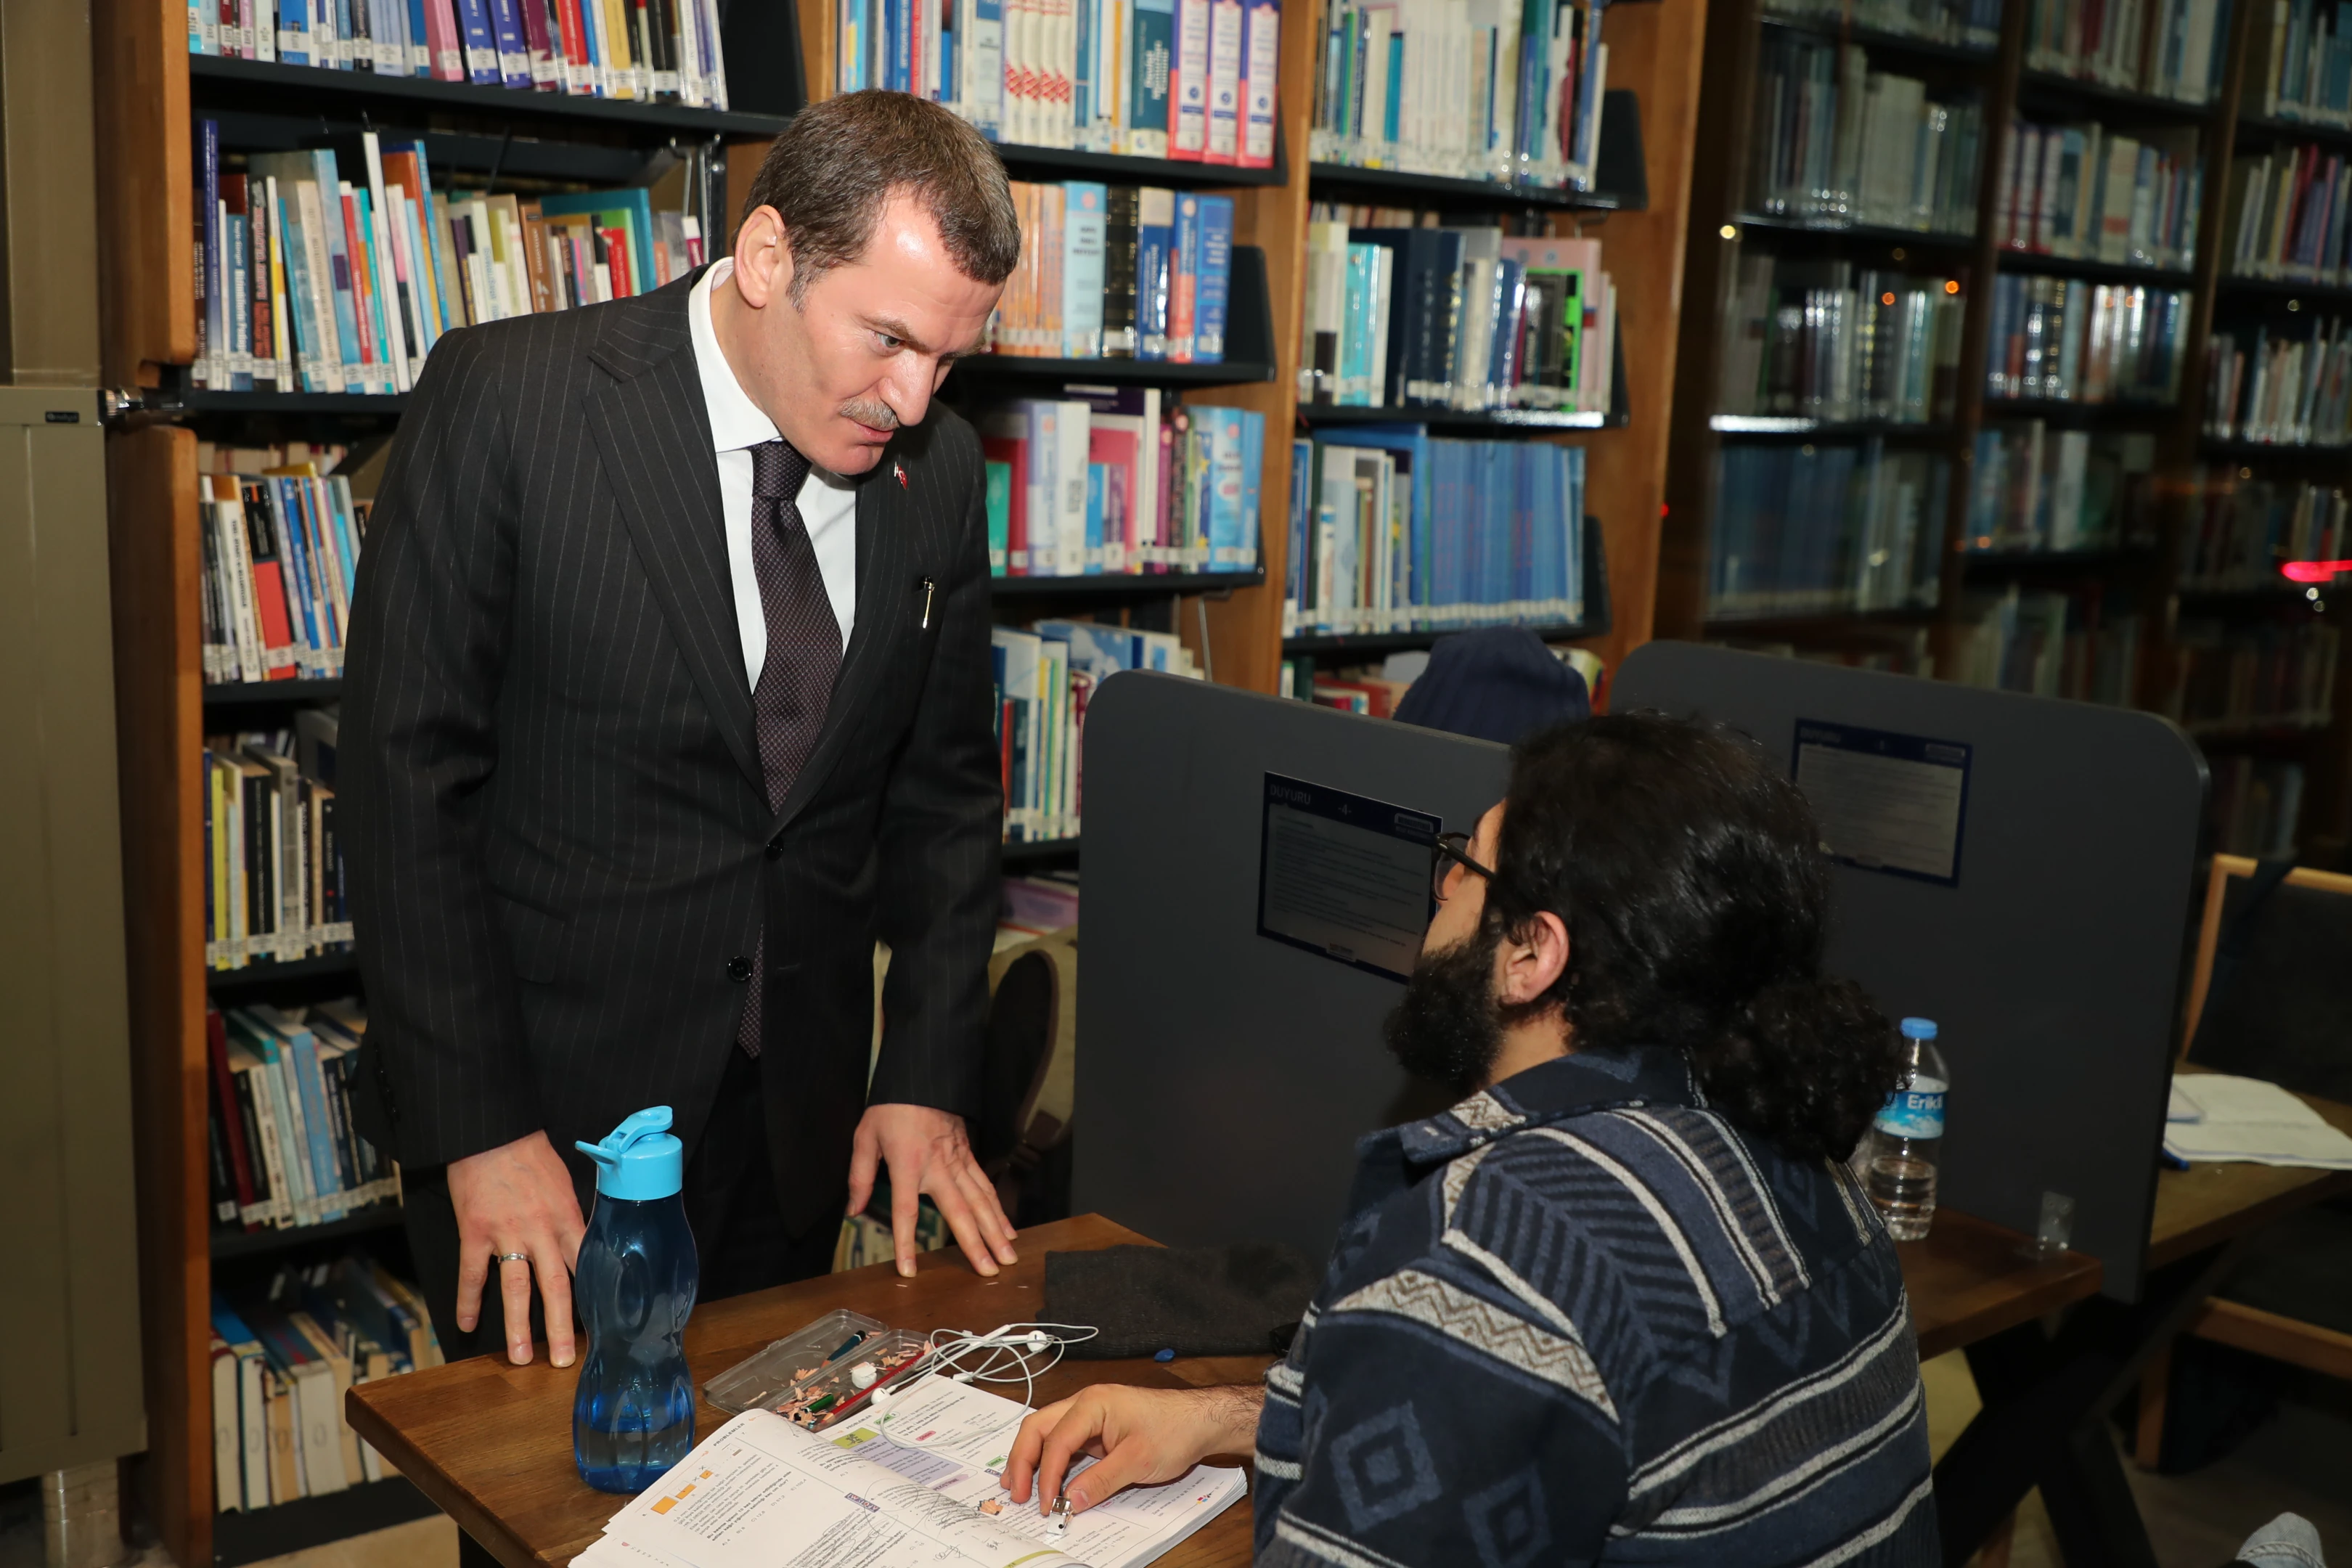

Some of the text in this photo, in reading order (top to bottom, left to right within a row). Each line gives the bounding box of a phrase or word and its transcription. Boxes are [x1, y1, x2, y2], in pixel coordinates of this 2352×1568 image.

[1270, 784, 1311, 805] DUYURU
[713, 1423, 744, 1446] PROBLEMLER
[713, 1522, 726, 1532] kesme
[750, 1493, 761, 1502] tekrar
[711, 1530, 724, 1540] edilen
